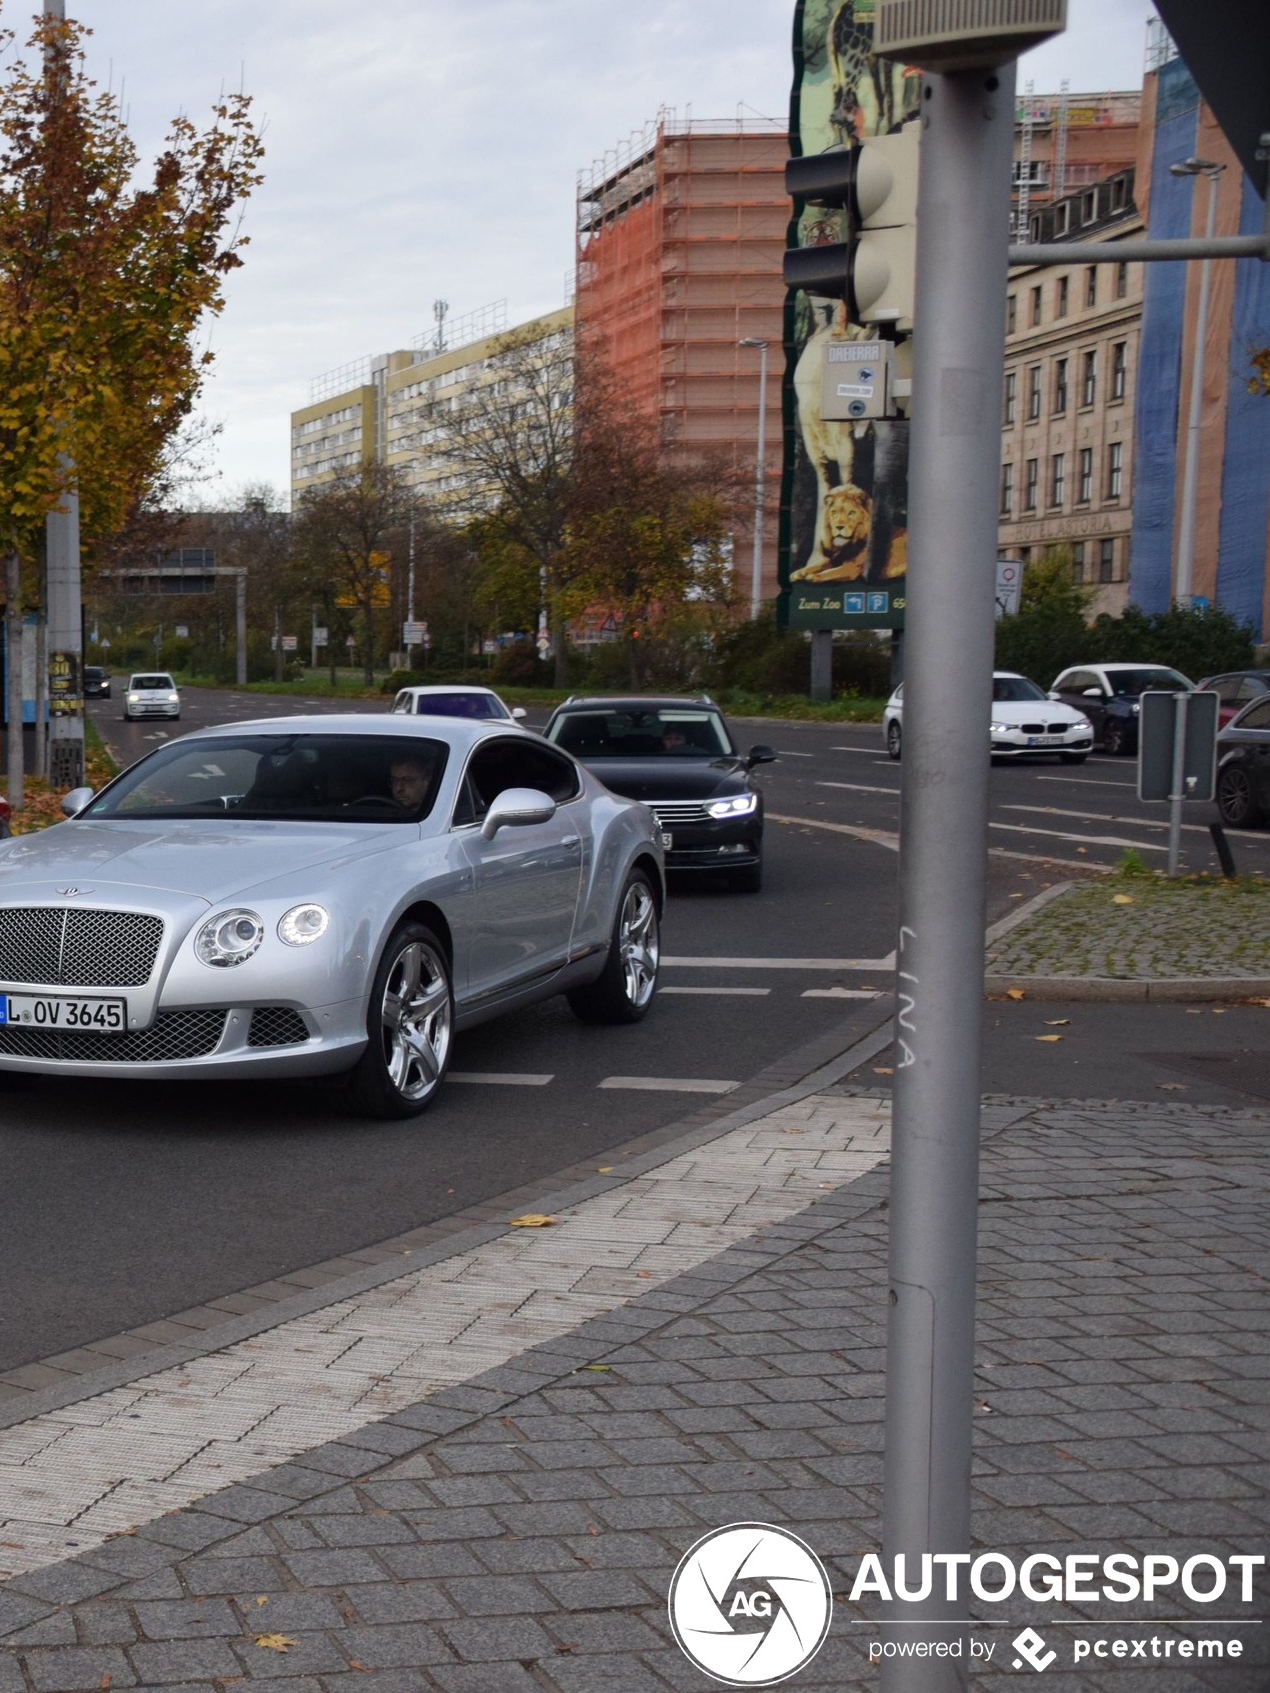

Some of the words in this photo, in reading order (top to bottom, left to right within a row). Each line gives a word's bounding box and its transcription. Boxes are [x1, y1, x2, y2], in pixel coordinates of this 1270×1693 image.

[1015, 523, 1053, 541] HOTEL
[1057, 515, 1112, 535] ASTORIA
[798, 597, 820, 610] Zum
[822, 597, 842, 610] Zoo
[898, 926, 919, 1069] LINA
[8, 999, 21, 1022] L
[34, 1000, 61, 1025] OV
[65, 1002, 121, 1028] 3645
